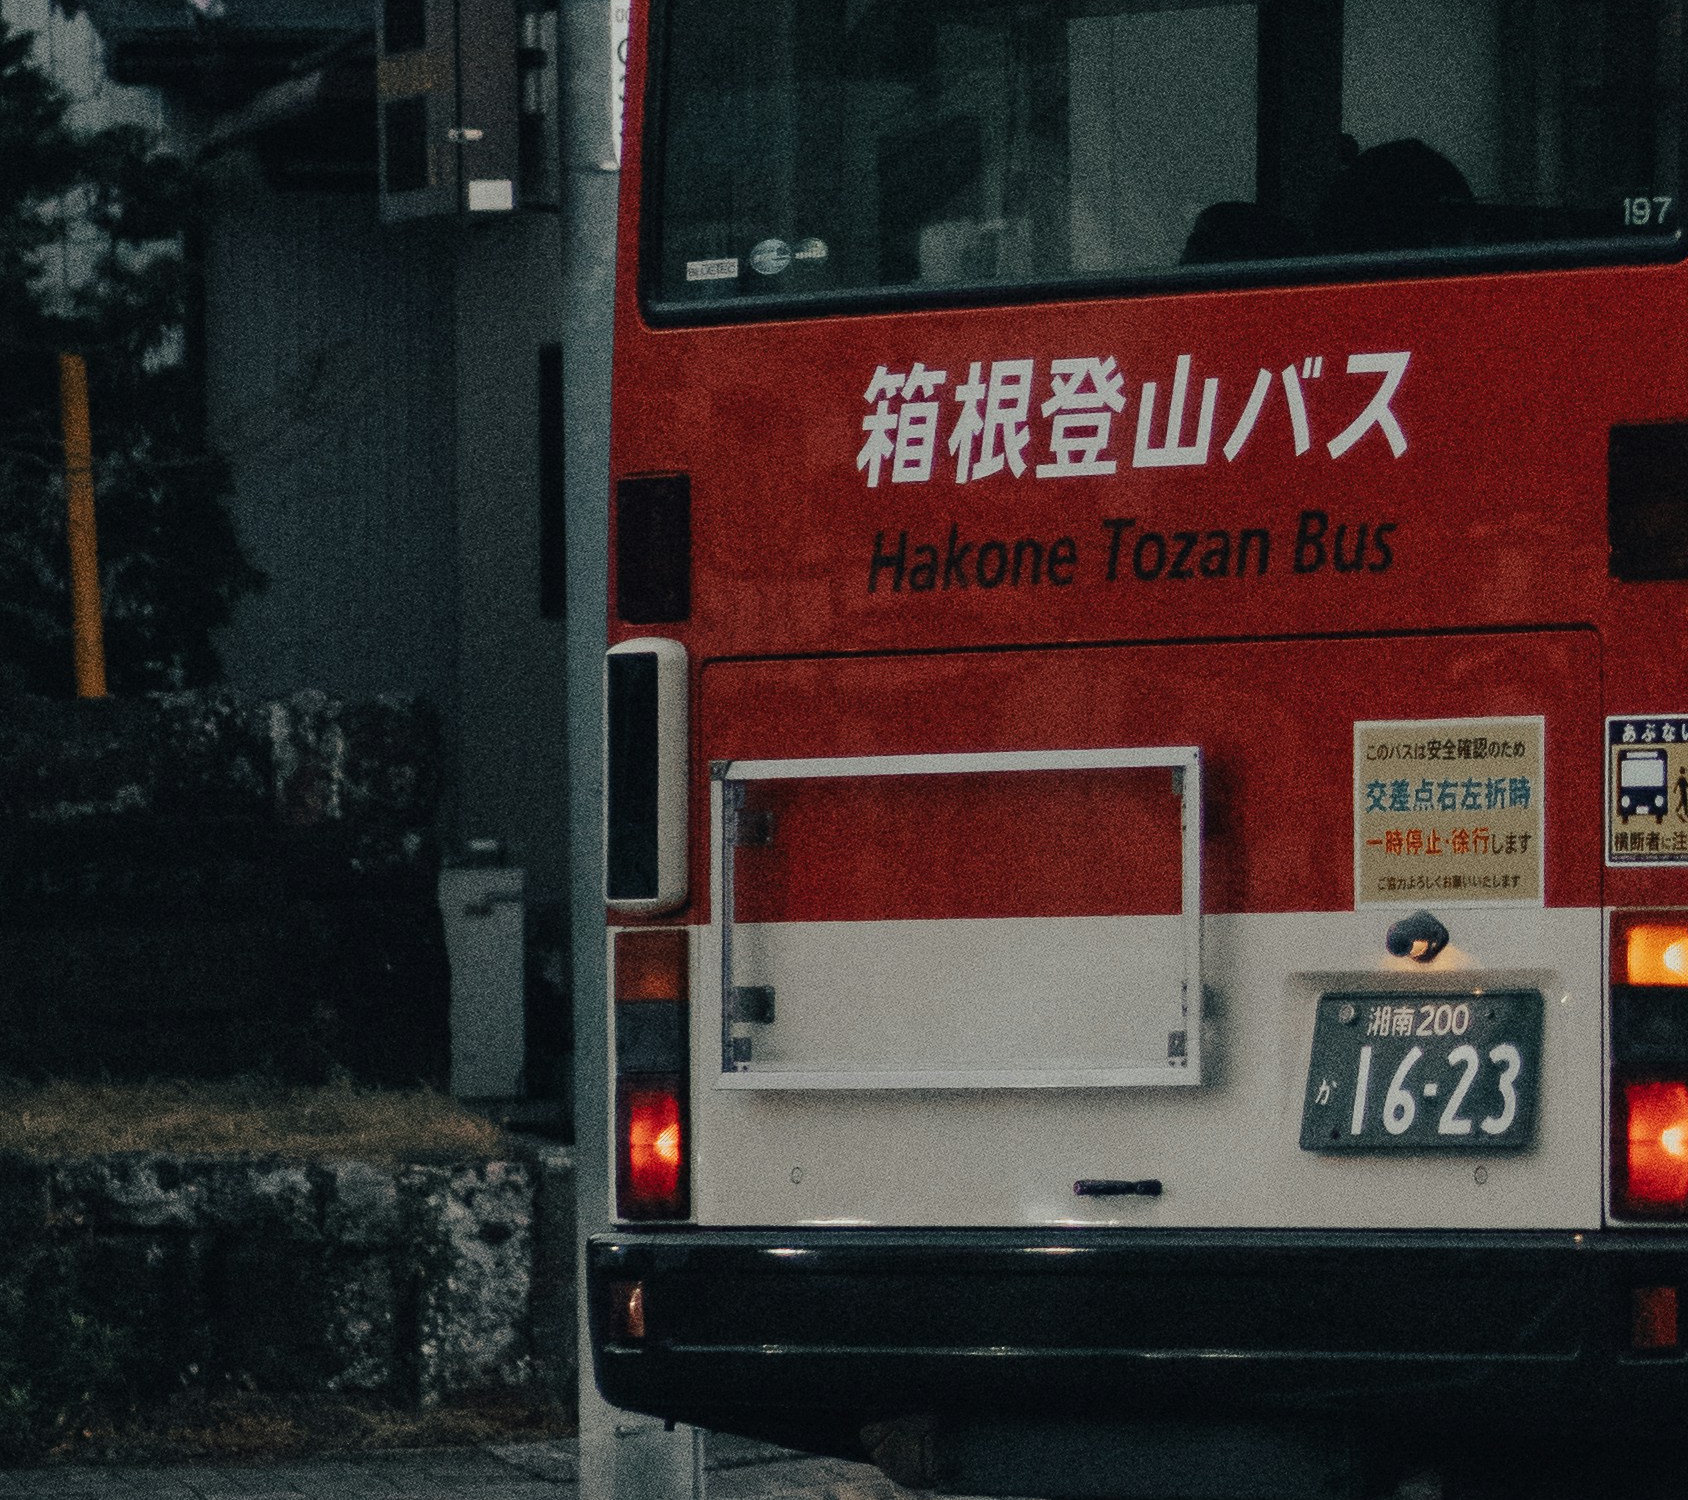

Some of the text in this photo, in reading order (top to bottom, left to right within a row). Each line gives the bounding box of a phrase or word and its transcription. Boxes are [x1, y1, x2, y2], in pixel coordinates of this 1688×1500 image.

[1623, 197, 1672, 226] 197
[855, 350, 1412, 489] 箱根登山バス
[867, 509, 1398, 595] Hakone Tozan Bus
[1366, 737, 1526, 761] このバスは安全確認のため
[1365, 776, 1532, 814] 交差点右左折時
[1314, 1079, 1338, 1105] か
